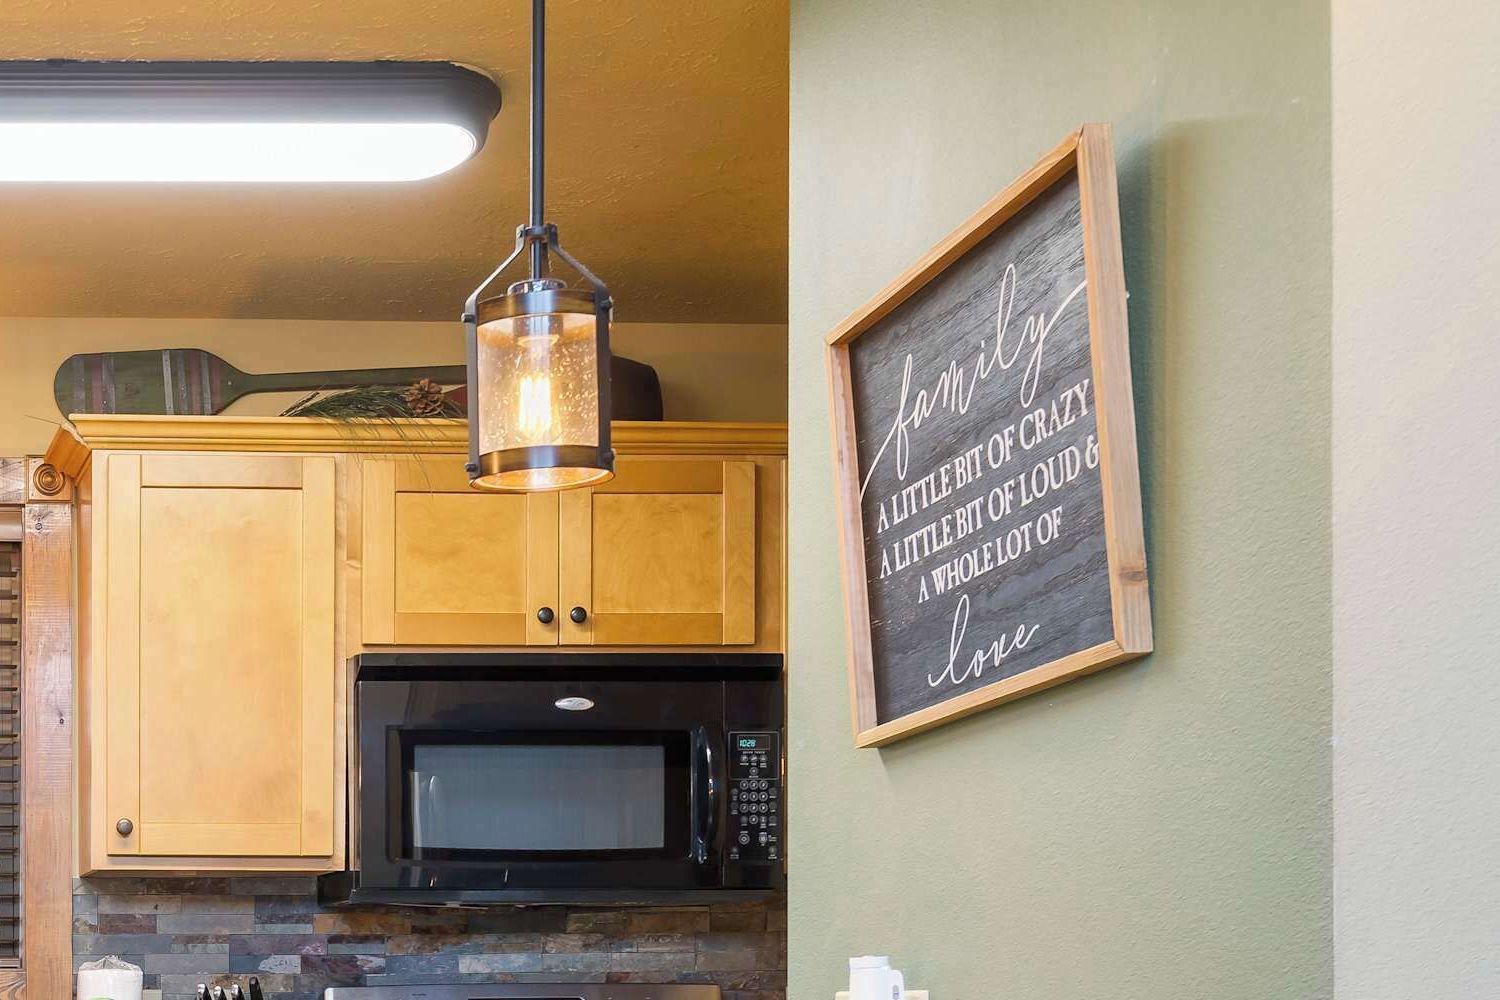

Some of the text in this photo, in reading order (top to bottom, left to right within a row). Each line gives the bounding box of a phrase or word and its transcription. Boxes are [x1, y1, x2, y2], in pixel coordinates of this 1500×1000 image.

[860, 264, 1088, 500] family
[877, 378, 1090, 534] A LITTLE BIT OF CRAZY
[879, 434, 1100, 579] A LITTLE BIT OF LOUD &
[917, 505, 1063, 603] A WHOLE LOT OF
[928, 594, 1040, 687] love
